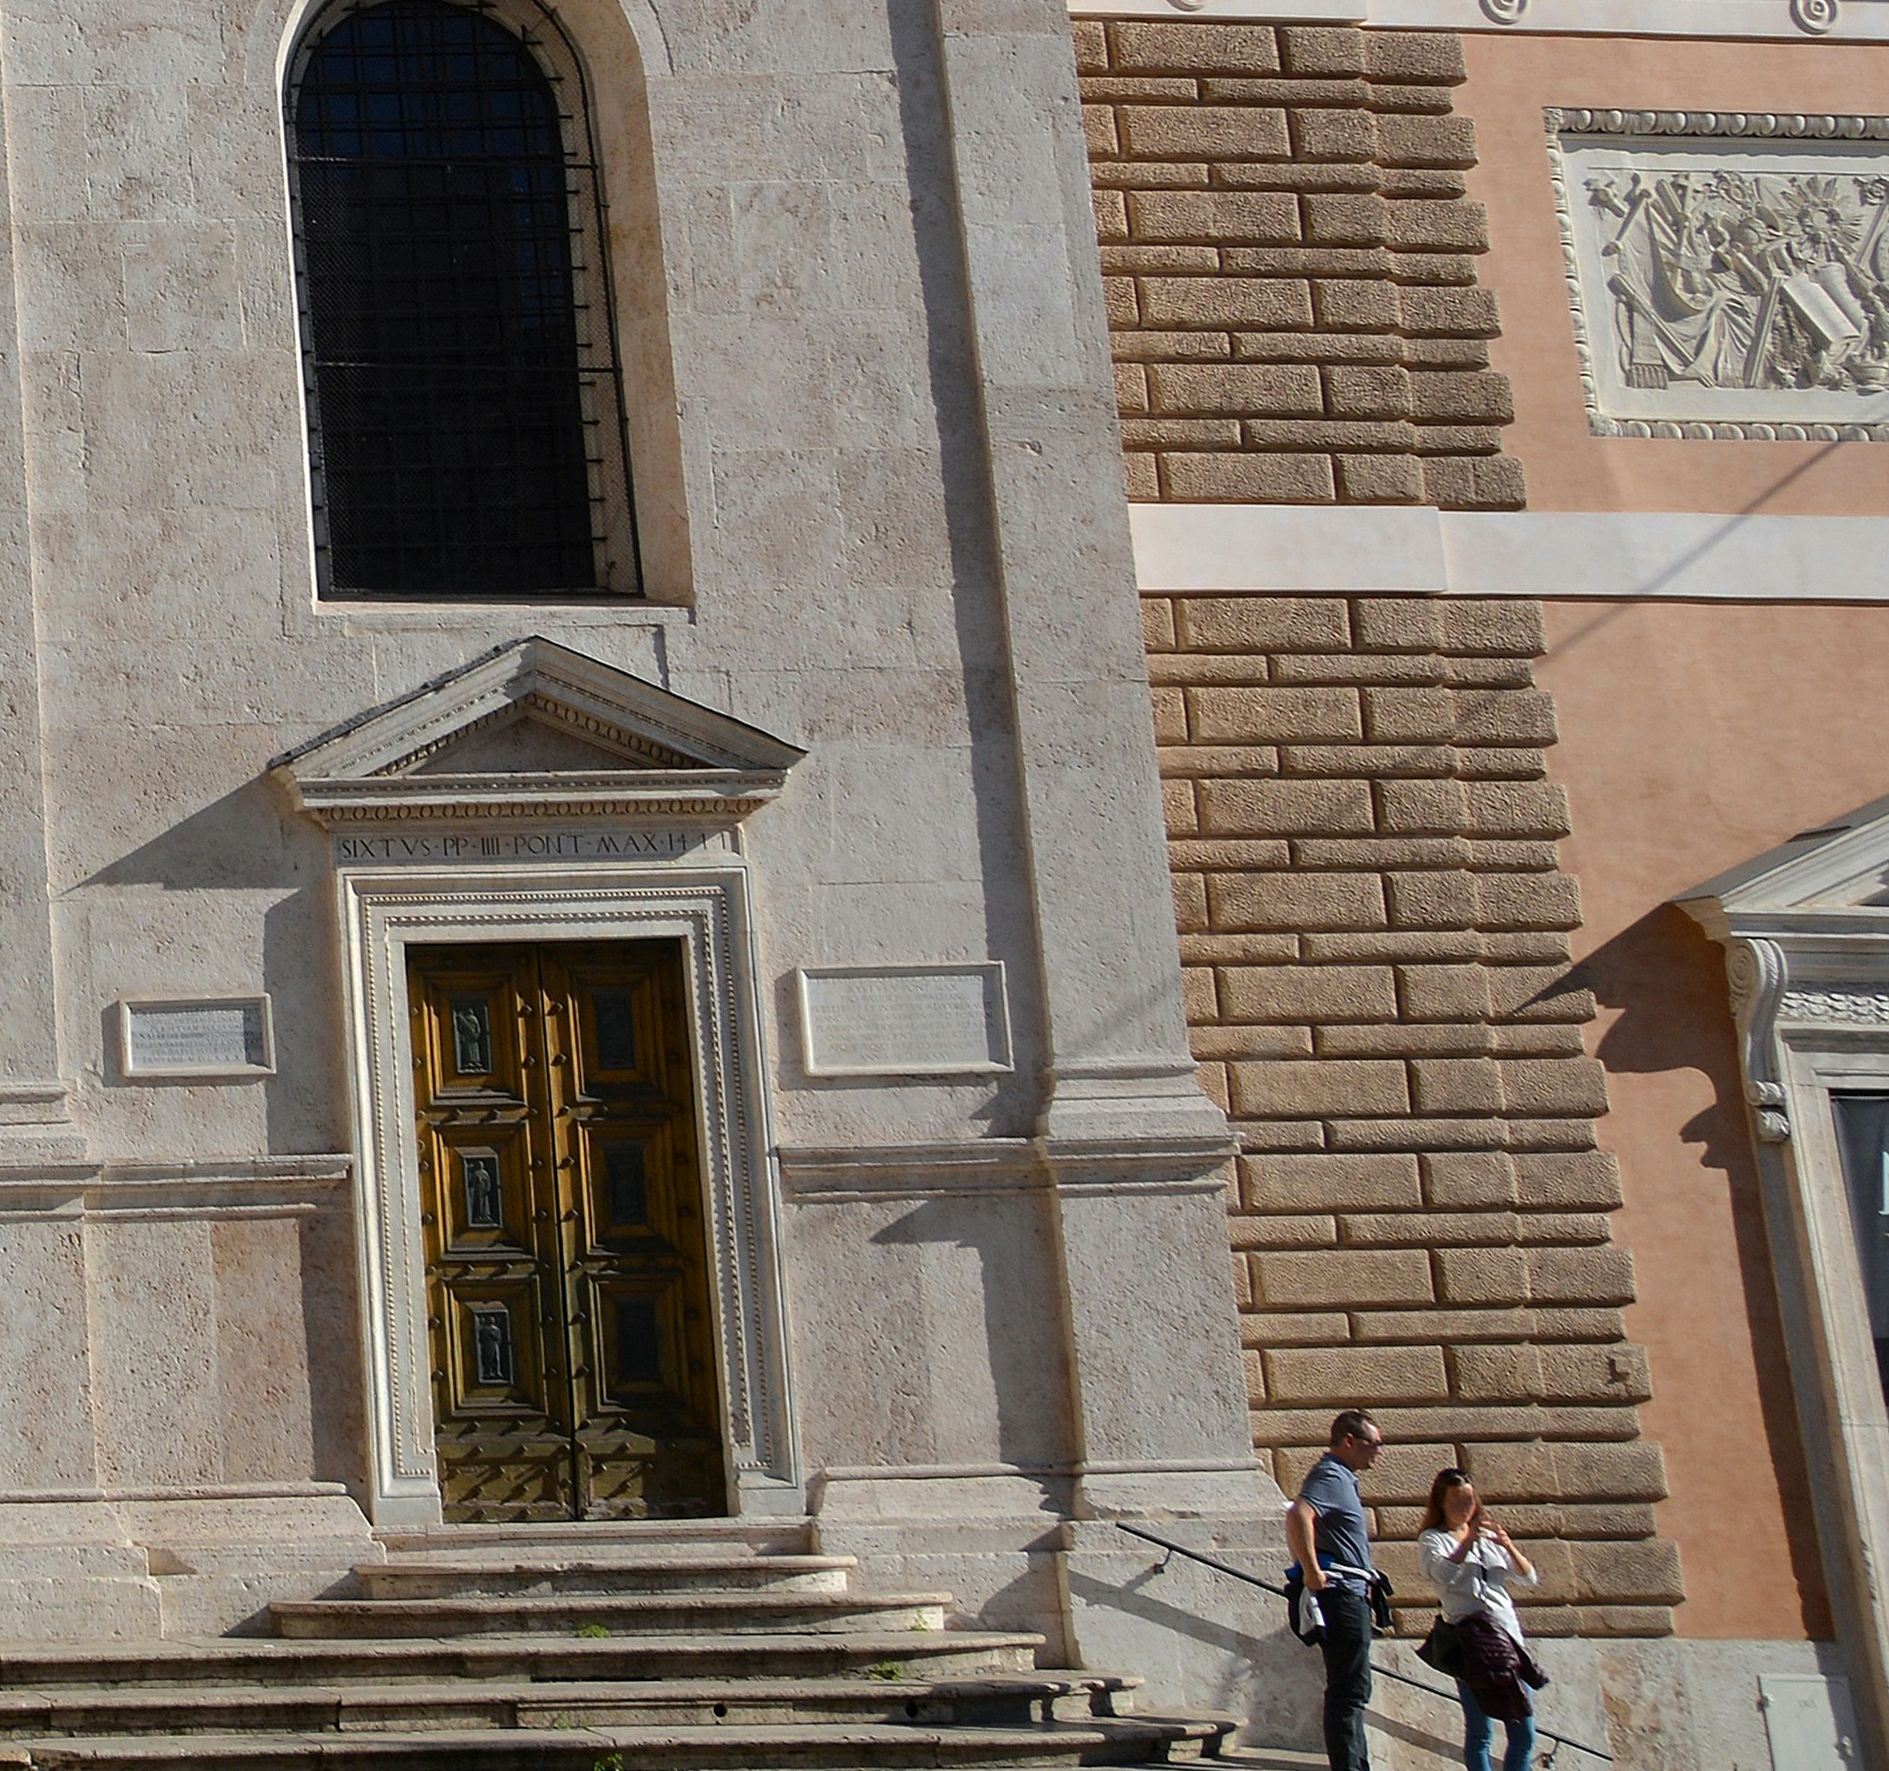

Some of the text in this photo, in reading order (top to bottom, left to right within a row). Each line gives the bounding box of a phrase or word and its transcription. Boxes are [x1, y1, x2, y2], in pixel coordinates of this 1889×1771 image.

[341, 837, 431, 858] SIXTVS
[443, 836, 468, 857] PP
[514, 833, 583, 855] PONT
[597, 833, 659, 854] MAX
